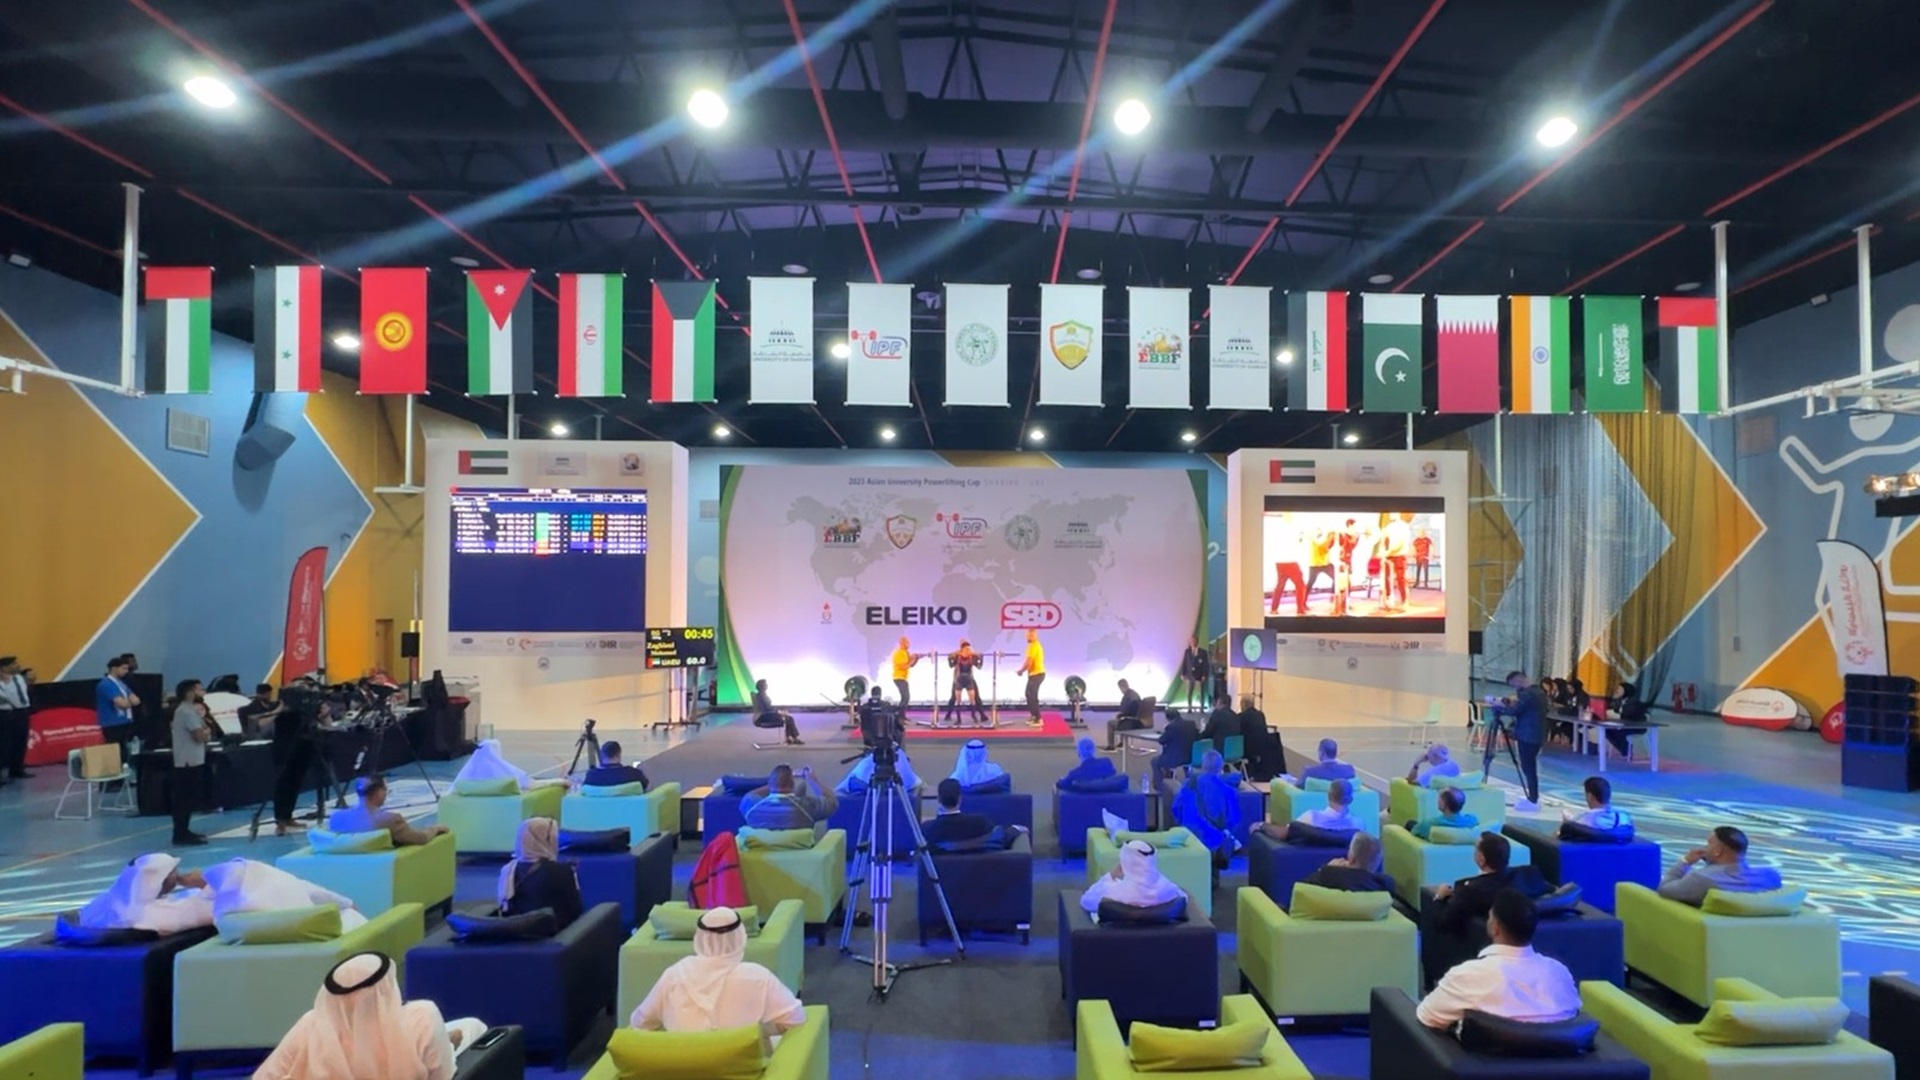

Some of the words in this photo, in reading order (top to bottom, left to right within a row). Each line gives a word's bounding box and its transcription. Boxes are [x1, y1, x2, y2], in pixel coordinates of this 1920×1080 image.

[870, 340, 902, 355] IPF
[1138, 351, 1181, 364] EBBF
[867, 477, 886, 486] Asian
[887, 477, 922, 488] University
[923, 477, 966, 488] Powerlifting
[966, 477, 981, 488] Cup
[953, 521, 982, 535] IPF
[822, 532, 860, 543] EBBF
[865, 606, 968, 625] ELEIKO
[1001, 602, 1062, 629] SBD
[684, 629, 714, 639] 00:45
[686, 656, 706, 665] 60.0
